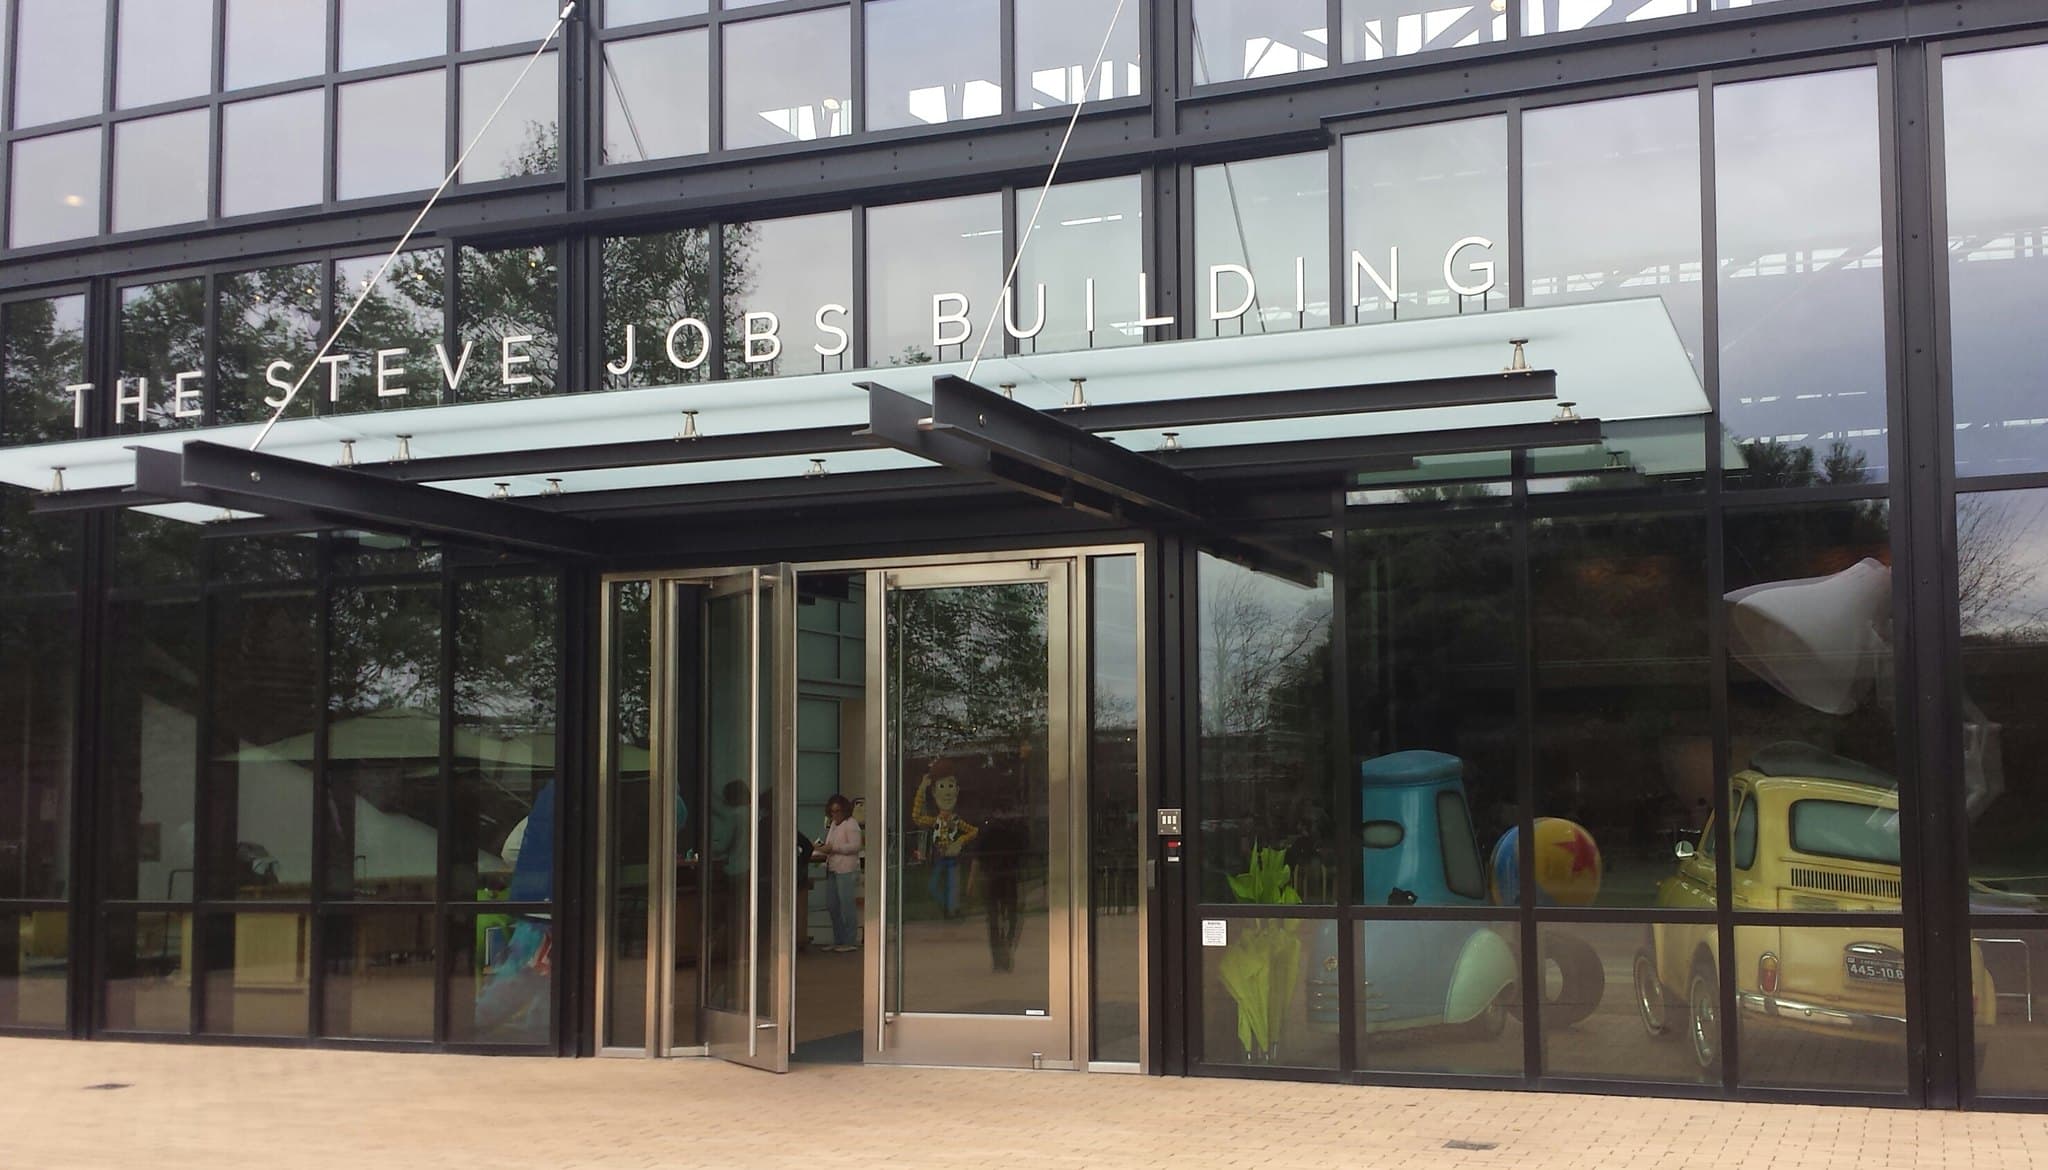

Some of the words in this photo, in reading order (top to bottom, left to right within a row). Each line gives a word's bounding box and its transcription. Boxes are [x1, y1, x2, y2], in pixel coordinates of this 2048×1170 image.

[65, 370, 205, 430] THE
[263, 334, 533, 409] STEVE
[606, 303, 850, 376] JOBS
[932, 236, 1496, 346] BUILDING
